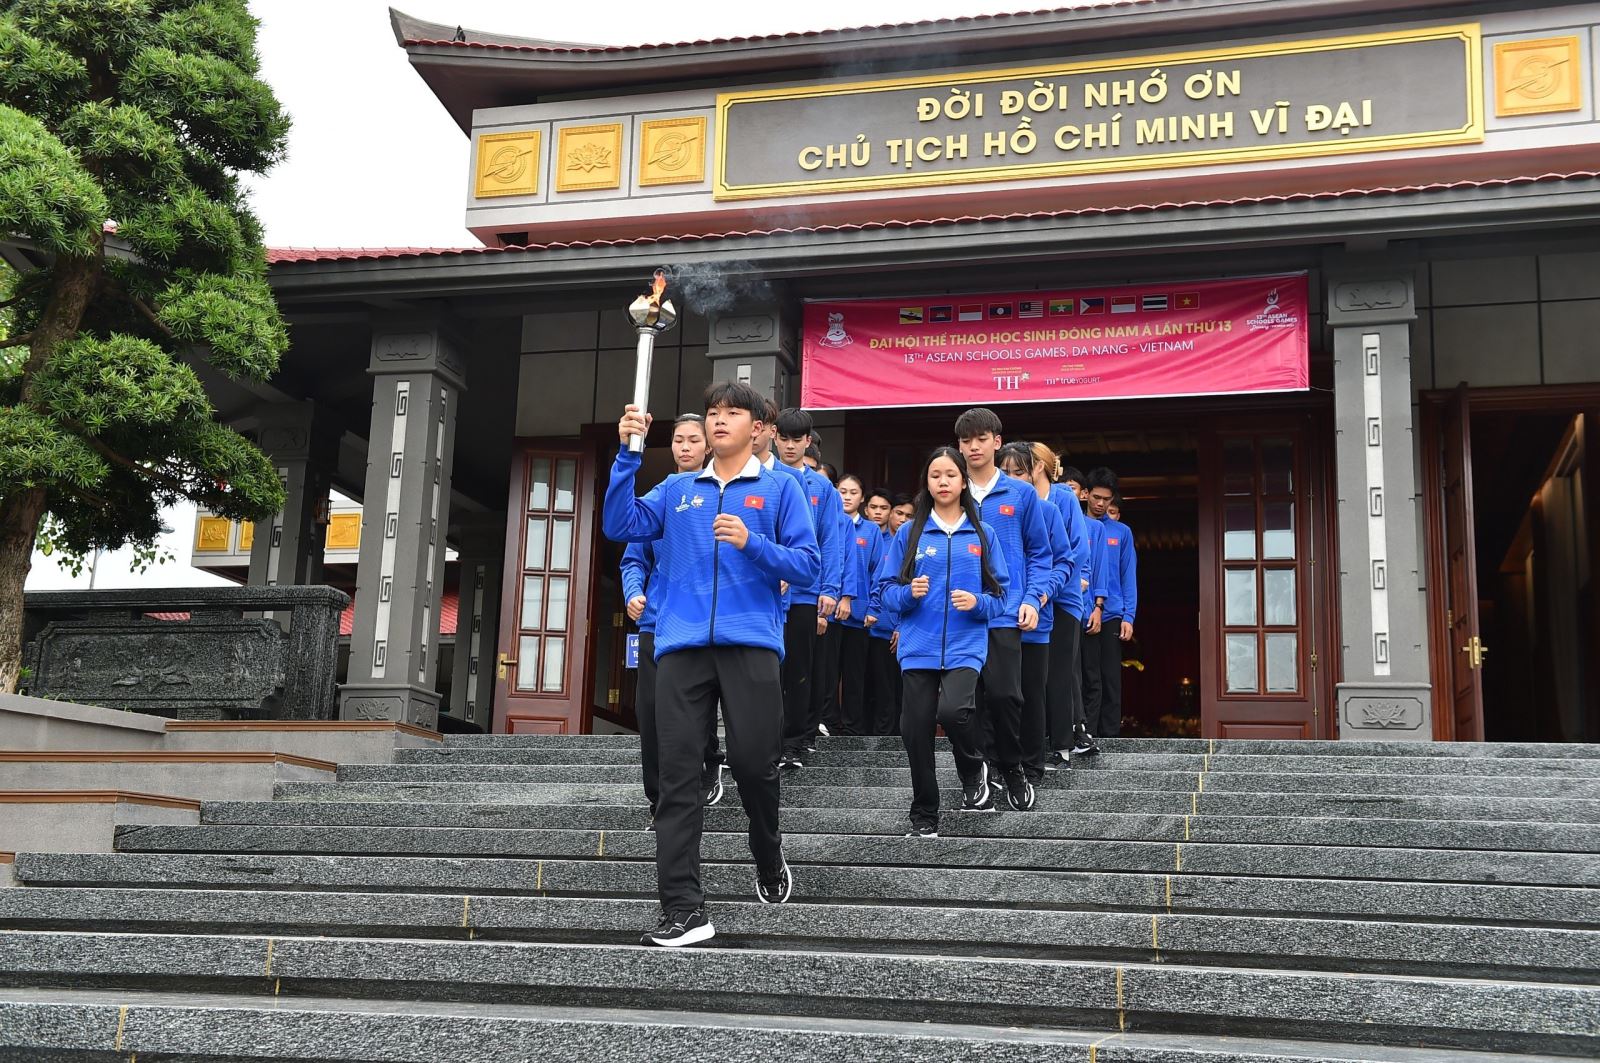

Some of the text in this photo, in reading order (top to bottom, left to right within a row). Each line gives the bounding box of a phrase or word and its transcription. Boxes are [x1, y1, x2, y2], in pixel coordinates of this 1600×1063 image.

[917, 69, 1241, 121] ĐỜI ĐỜI NHỚ ƠN
[798, 99, 1372, 170] CHỦ TỊCH HỒ CHÍ MINH VĨ ĐẠI
[869, 337, 892, 351] ĐẠI
[895, 334, 920, 349] HỘI
[923, 331, 947, 347] THỂ
[950, 333, 988, 345] THAO
[991, 331, 1021, 345] HỌC
[1023, 329, 1056, 342] SINH
[1059, 326, 1101, 340] ĐÔNG
[1105, 326, 1139, 339] NAM
[1218, 320, 1232, 332] 13
[904, 352, 924, 364] 13TH
[926, 351, 963, 362] ASEAN
[966, 348, 1021, 361] SCHOOLS
[1024, 346, 1069, 358] GAMES,
[1072, 346, 1089, 357] DA
[1092, 343, 1129, 355] NANG
[1139, 340, 1194, 353] VIETNAM
[993, 375, 1020, 391] TH
